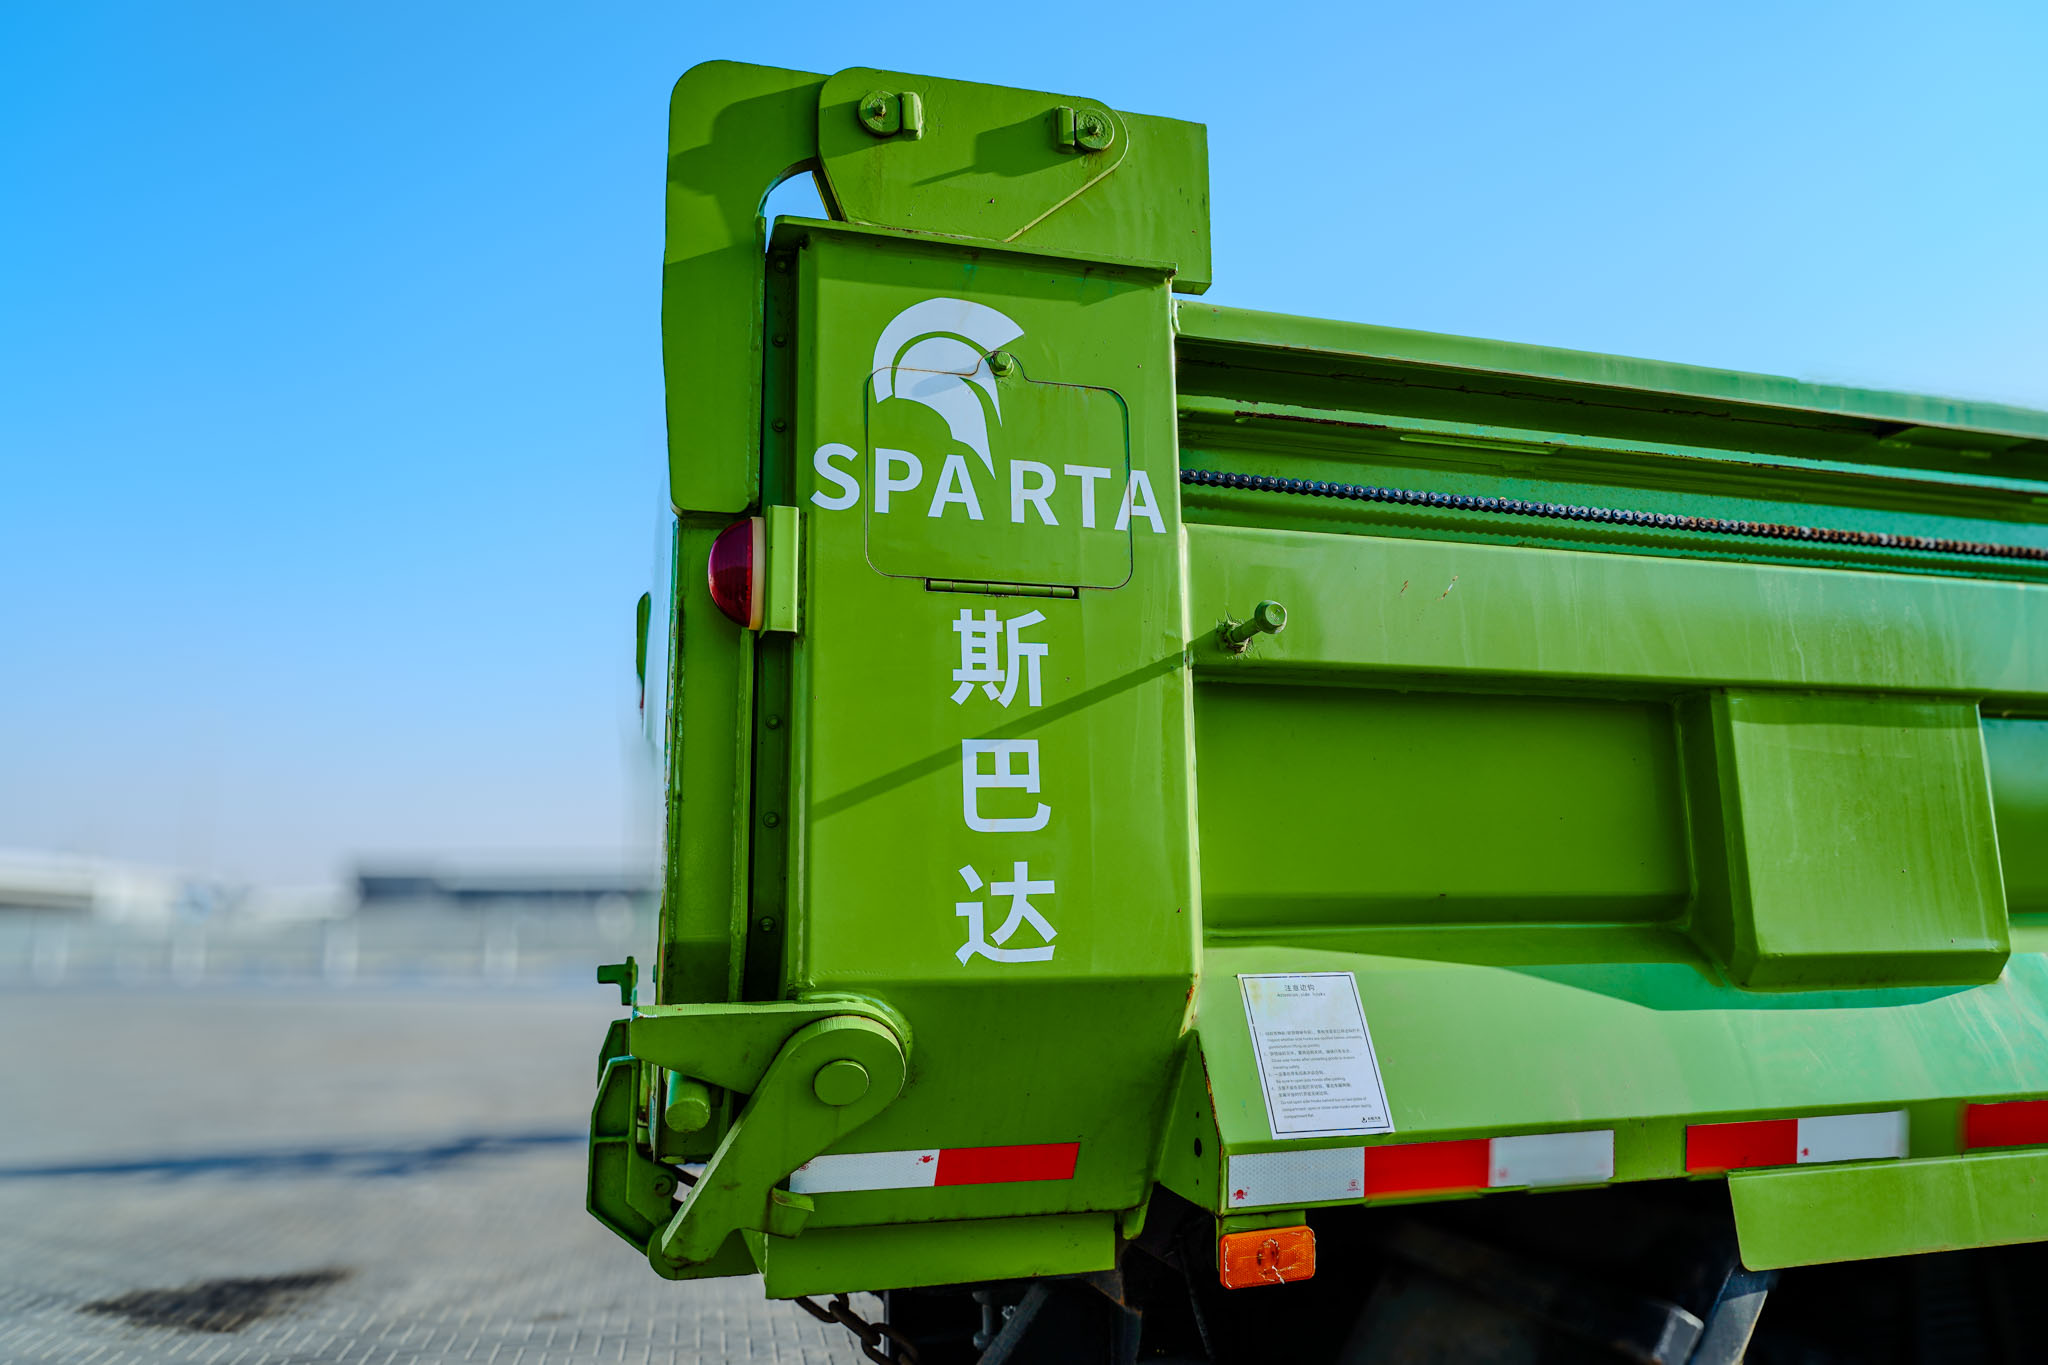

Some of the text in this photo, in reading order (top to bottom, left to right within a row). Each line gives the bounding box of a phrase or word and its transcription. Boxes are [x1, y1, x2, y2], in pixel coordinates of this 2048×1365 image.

[811, 443, 1167, 533] SPARTA
[951, 609, 1057, 966] 斯巴达
